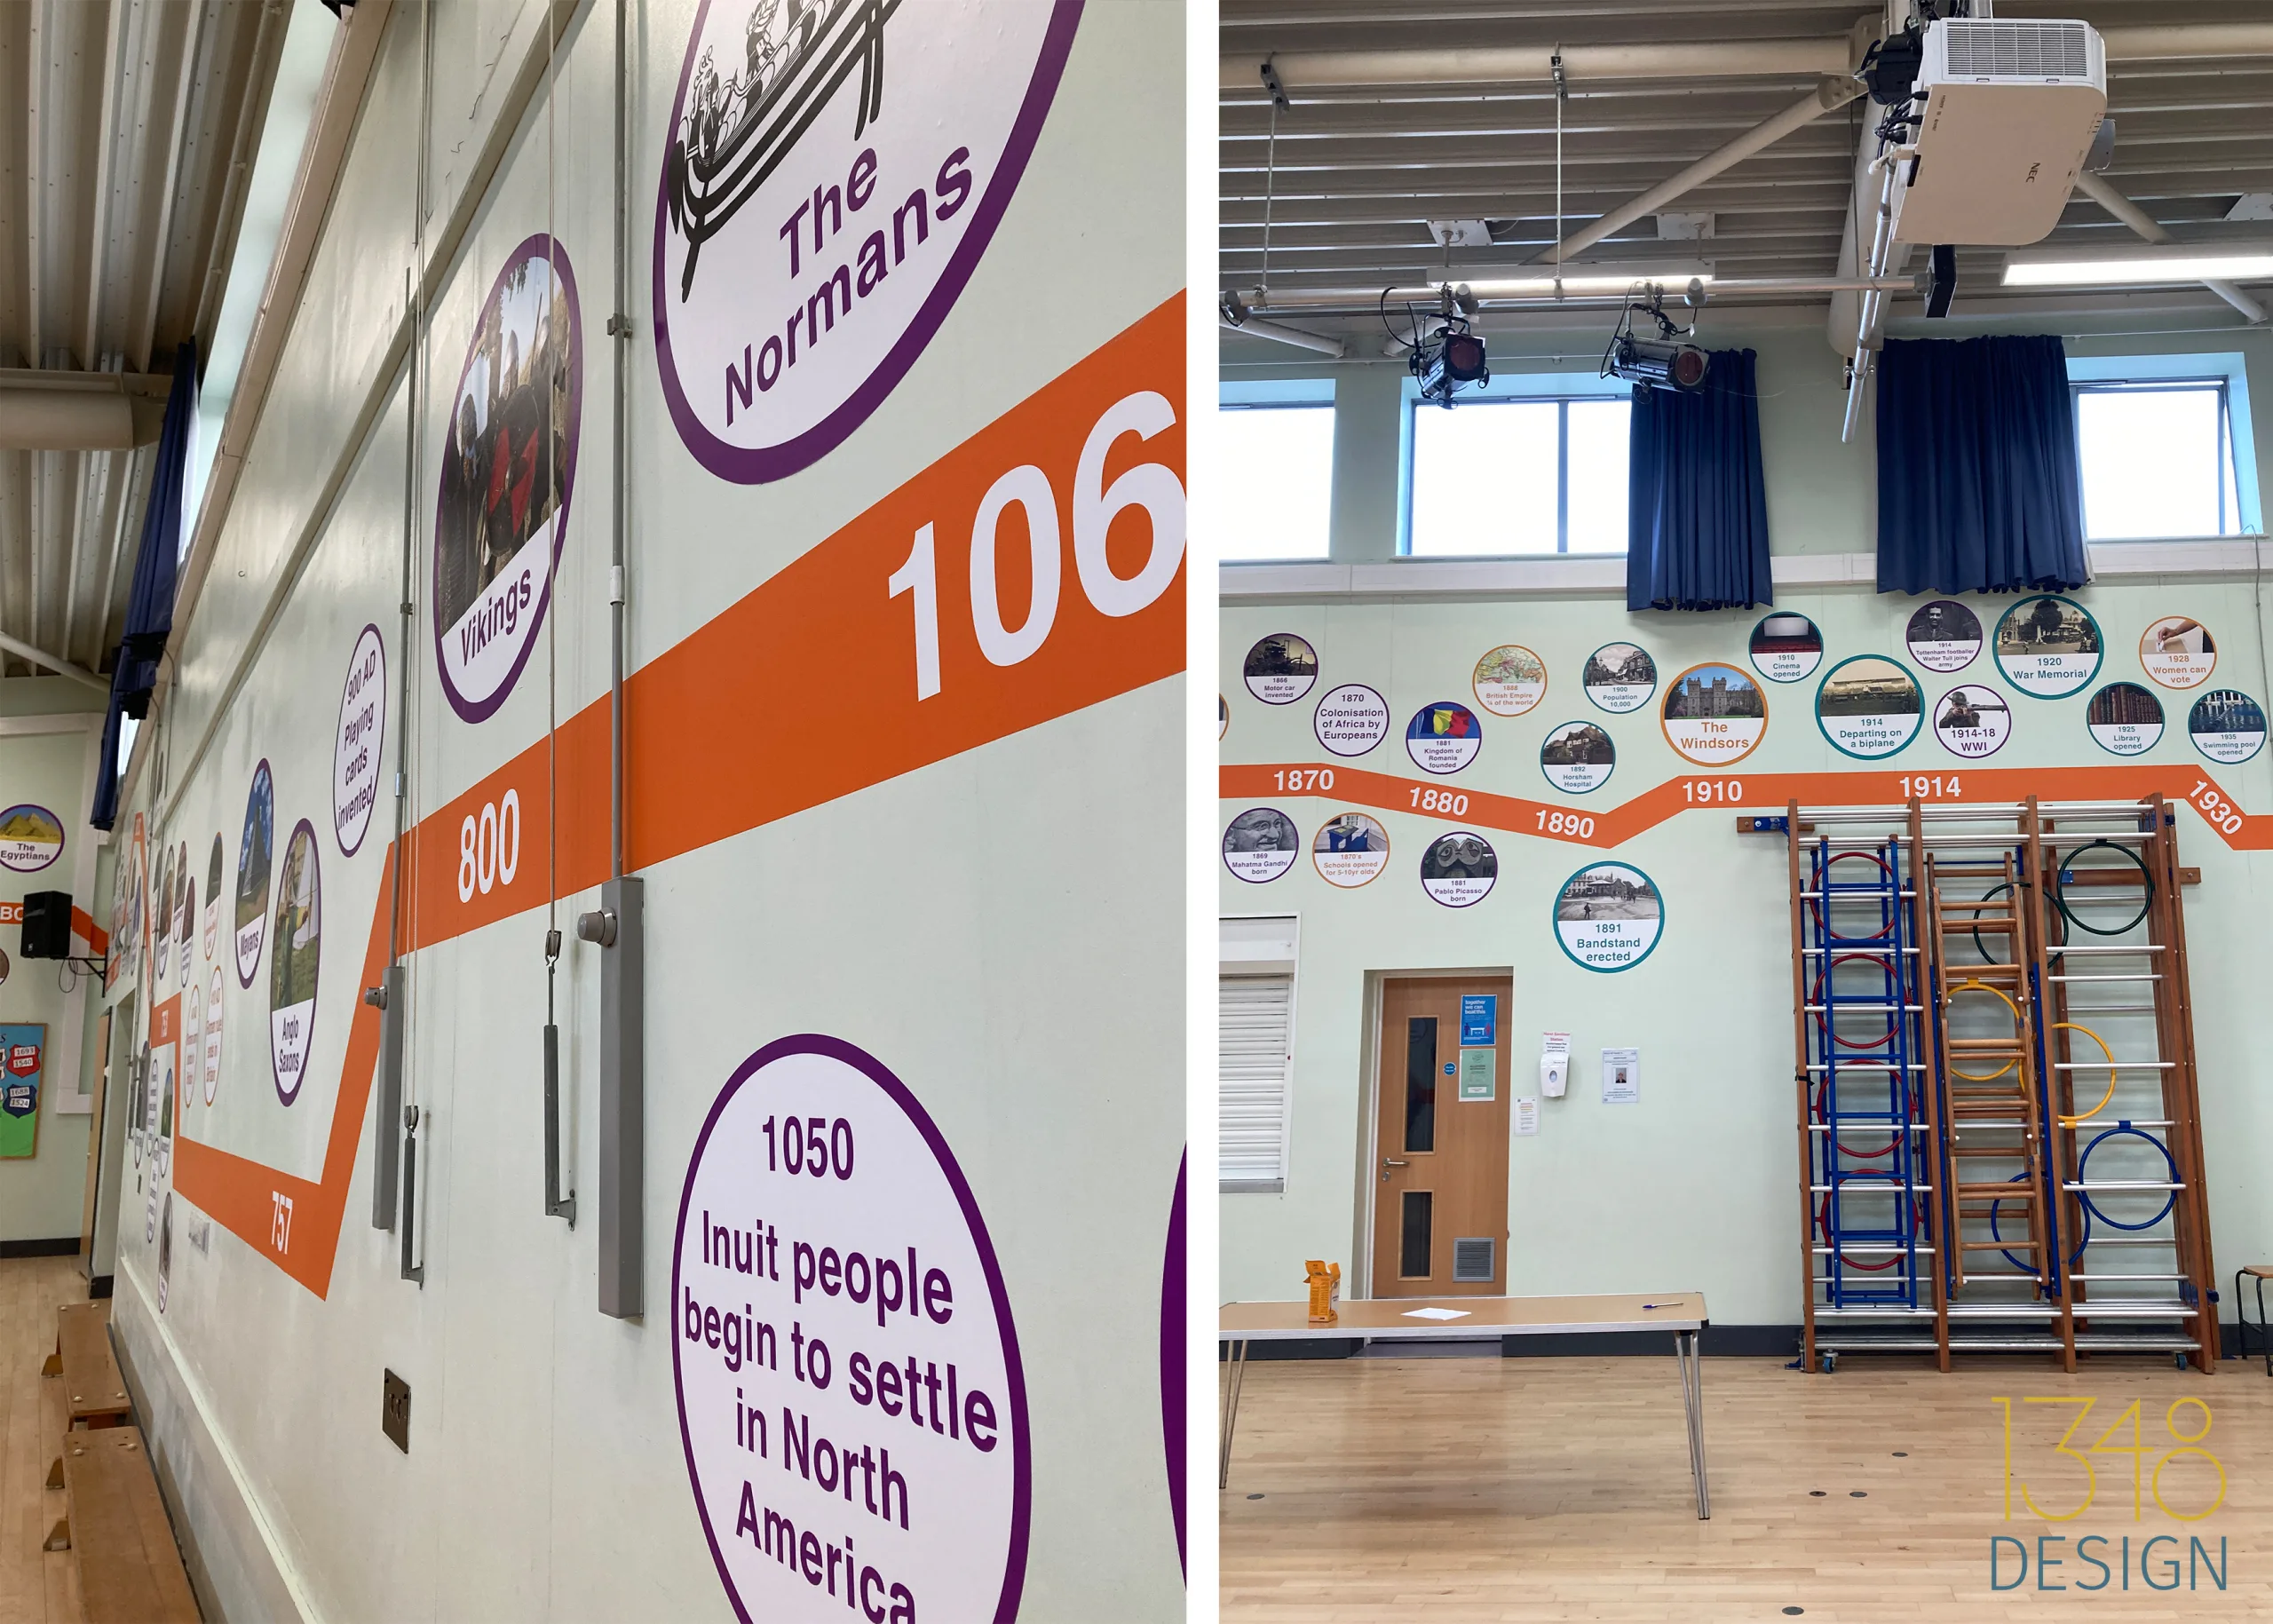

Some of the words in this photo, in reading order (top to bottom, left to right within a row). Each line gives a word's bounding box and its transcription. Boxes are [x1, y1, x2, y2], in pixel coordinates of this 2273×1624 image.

[2026, 162, 2040, 183] NEC
[780, 147, 877, 280] The
[725, 145, 971, 428] Normans
[888, 390, 1186, 702] 106
[462, 568, 531, 667] Vikings
[2013, 670, 2034, 679] War
[2038, 669, 2087, 678] Memorial
[2037, 657, 2062, 666] 1920
[347, 670, 361, 705] 900
[362, 649, 376, 687] AD
[345, 701, 374, 751] Playing
[1324, 731, 1378, 741] Europeans
[1368, 720, 1381, 730] by
[1701, 721, 1728, 733] The
[1840, 729, 1887, 739] Departing
[1951, 728, 1996, 739] 1914-18
[1681, 737, 1749, 749] Windsors
[1859, 739, 1895, 749] biplane
[1961, 741, 1987, 751] WWI
[345, 746, 368, 786] cards
[1274, 769, 1334, 791] 1870
[1683, 780, 1743, 803] 1910
[1899, 776, 1962, 798] 1914
[338, 775, 373, 830] invented
[1409, 787, 1469, 816] 1880
[2190, 780, 2243, 835] 1930
[1536, 810, 1595, 838] 1890
[0, 850, 50, 860] Egyptians
[458, 788, 519, 904] 800
[1596, 923, 1621, 933] 1891
[240, 931, 259, 960] Mayans
[1577, 938, 1641, 948] Bandstand
[1586, 951, 1630, 962] erected
[282, 1014, 298, 1046] Anglo
[279, 1049, 299, 1073] Saxons
[763, 1115, 854, 1180] 1050
[272, 1190, 293, 1255] 757
[702, 1209, 779, 1283] Inuit
[795, 1240, 954, 1328] people
[685, 1286, 777, 1373] begin
[791, 1321, 831, 1390] to
[849, 1351, 998, 1454] settle
[736, 1387, 768, 1459] in
[784, 1406, 909, 1532] North
